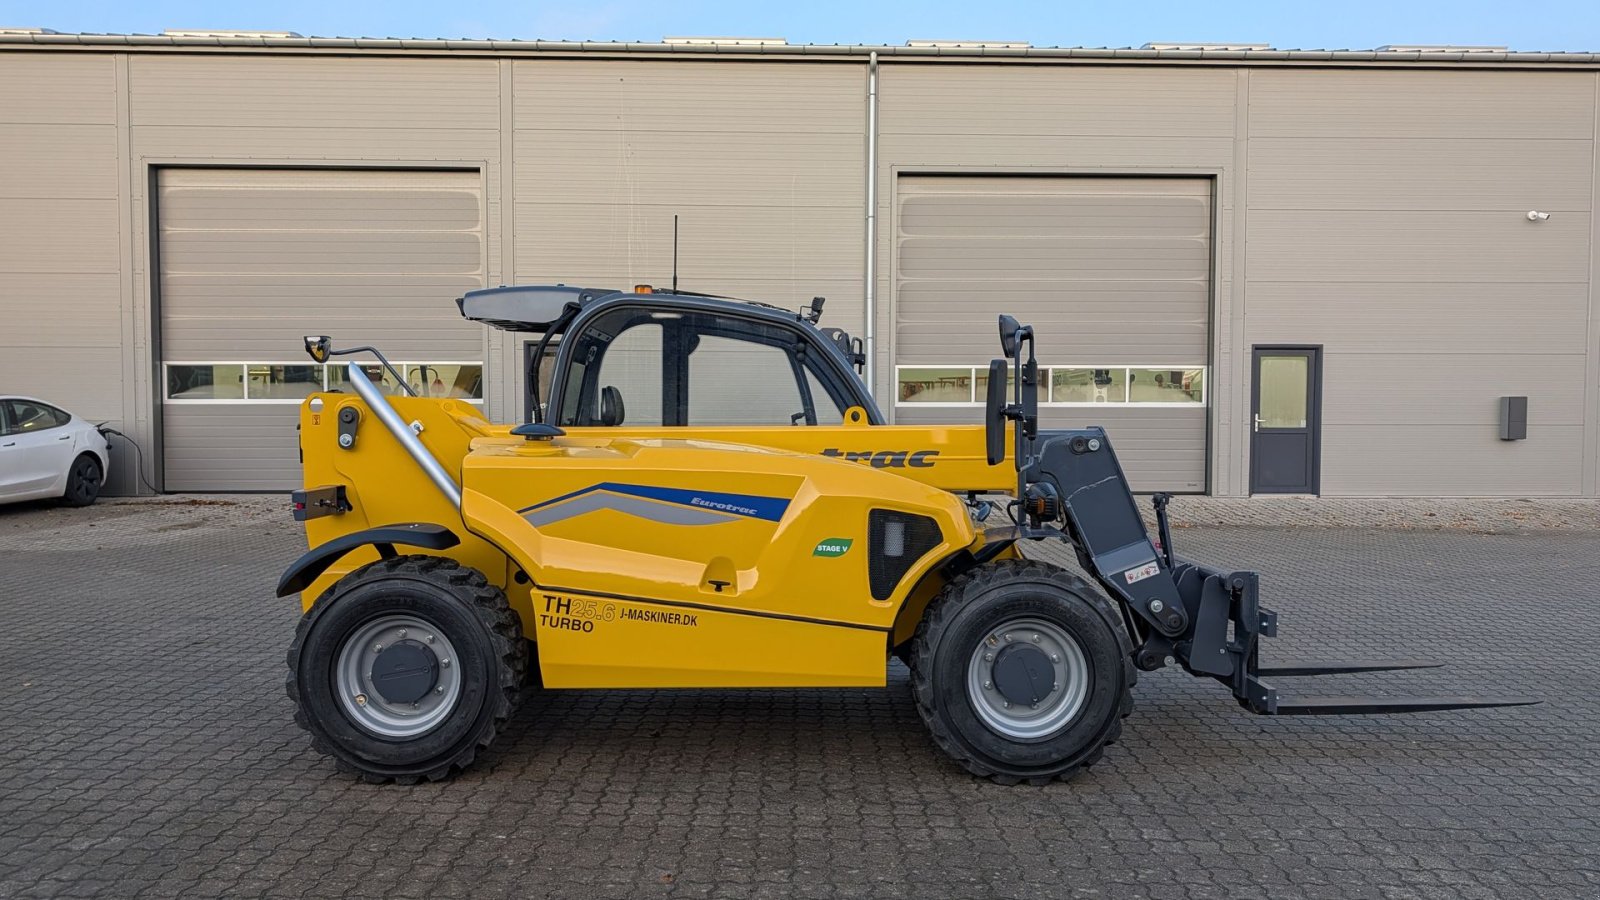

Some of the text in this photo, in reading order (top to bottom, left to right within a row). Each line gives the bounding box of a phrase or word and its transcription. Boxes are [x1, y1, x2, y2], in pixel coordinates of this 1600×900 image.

[690, 496, 758, 515] Eurotrac
[817, 544, 848, 553] STAGE V
[540, 614, 594, 633] TURBO
[619, 607, 698, 627] J-MASKINER.DK
